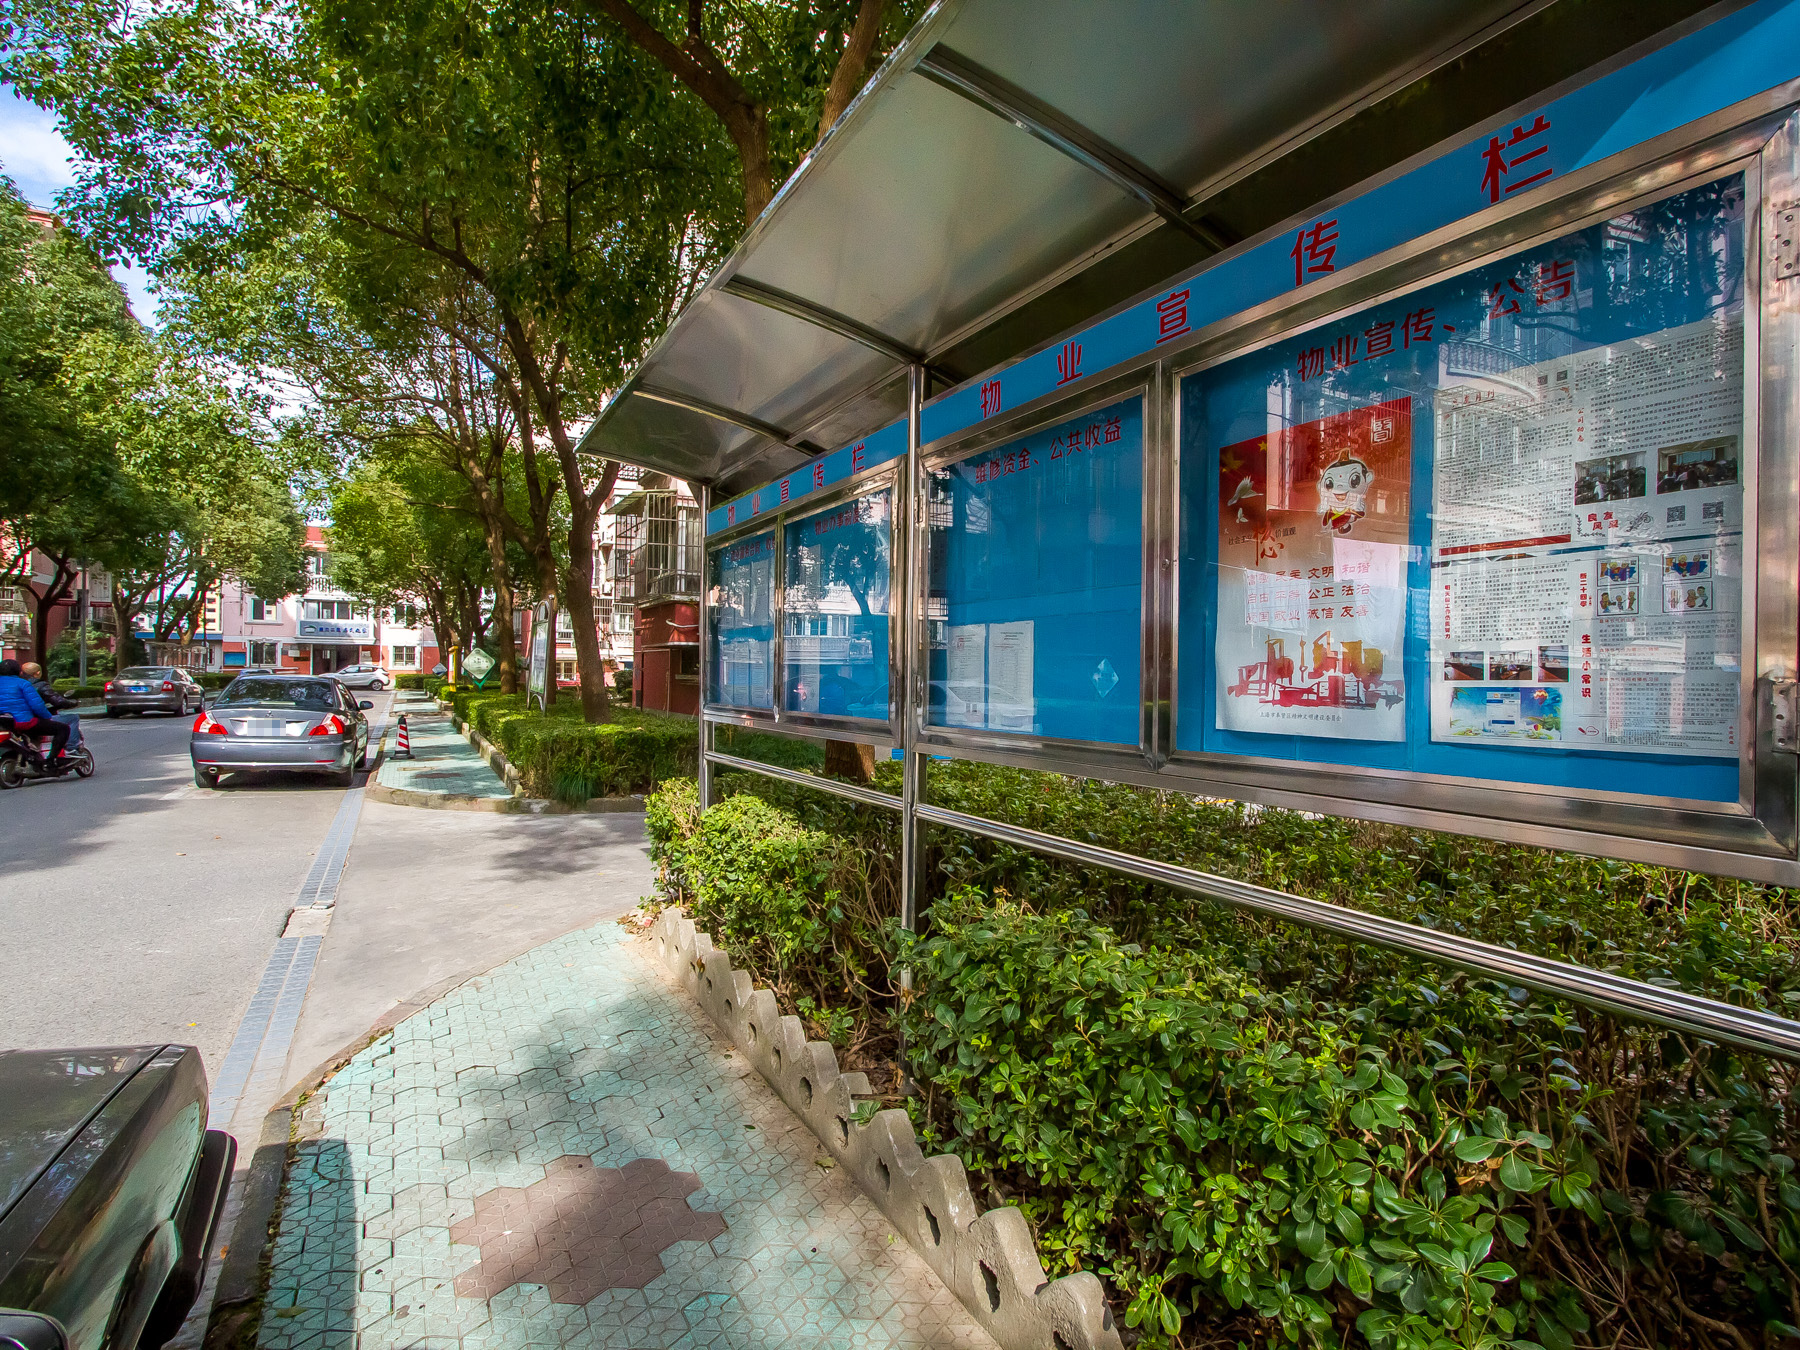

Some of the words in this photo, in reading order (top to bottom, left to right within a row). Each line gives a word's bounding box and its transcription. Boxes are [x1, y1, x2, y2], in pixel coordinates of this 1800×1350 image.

[980, 115, 1553, 420] 物业宣传栏
[1297, 259, 1576, 381] 物业宣传、公告
[975, 416, 1122, 485] 维修资金、公共收益
[727, 442, 865, 527] 物业宣传栏
[1247, 591, 1270, 604] 自由
[1307, 586, 1335, 600] 公正
[1341, 583, 1371, 597] 法治
[1275, 569, 1302, 582] 民主
[1308, 565, 1334, 579] 文明
[1341, 562, 1371, 575] 和谐
[1307, 607, 1335, 620] 诚信
[1340, 604, 1370, 618] 友善
[1581, 634, 1592, 699] 生活小常识
